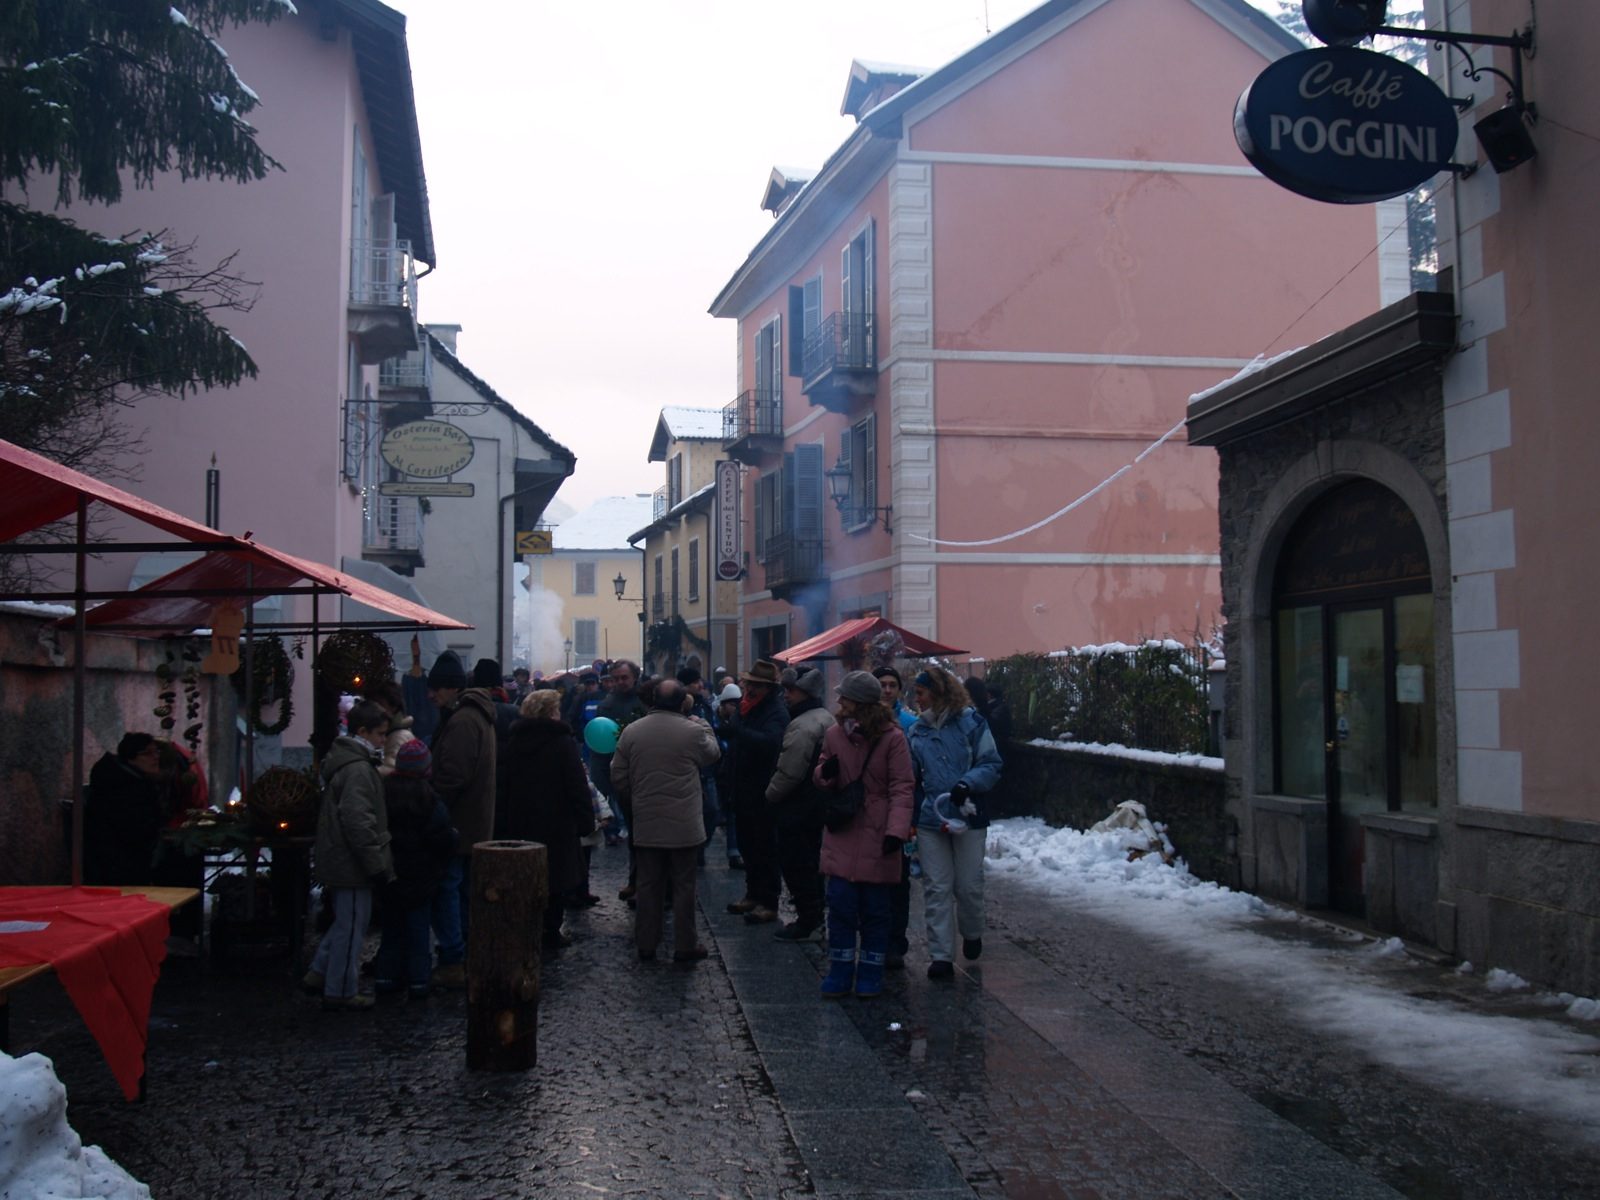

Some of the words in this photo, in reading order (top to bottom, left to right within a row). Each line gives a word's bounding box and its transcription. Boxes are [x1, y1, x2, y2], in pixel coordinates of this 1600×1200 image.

[1269, 114, 1438, 163] POGGINI
[392, 423, 441, 440] Osteria
[443, 426, 463, 442] Bar
[725, 515, 733, 553] CENTRO
